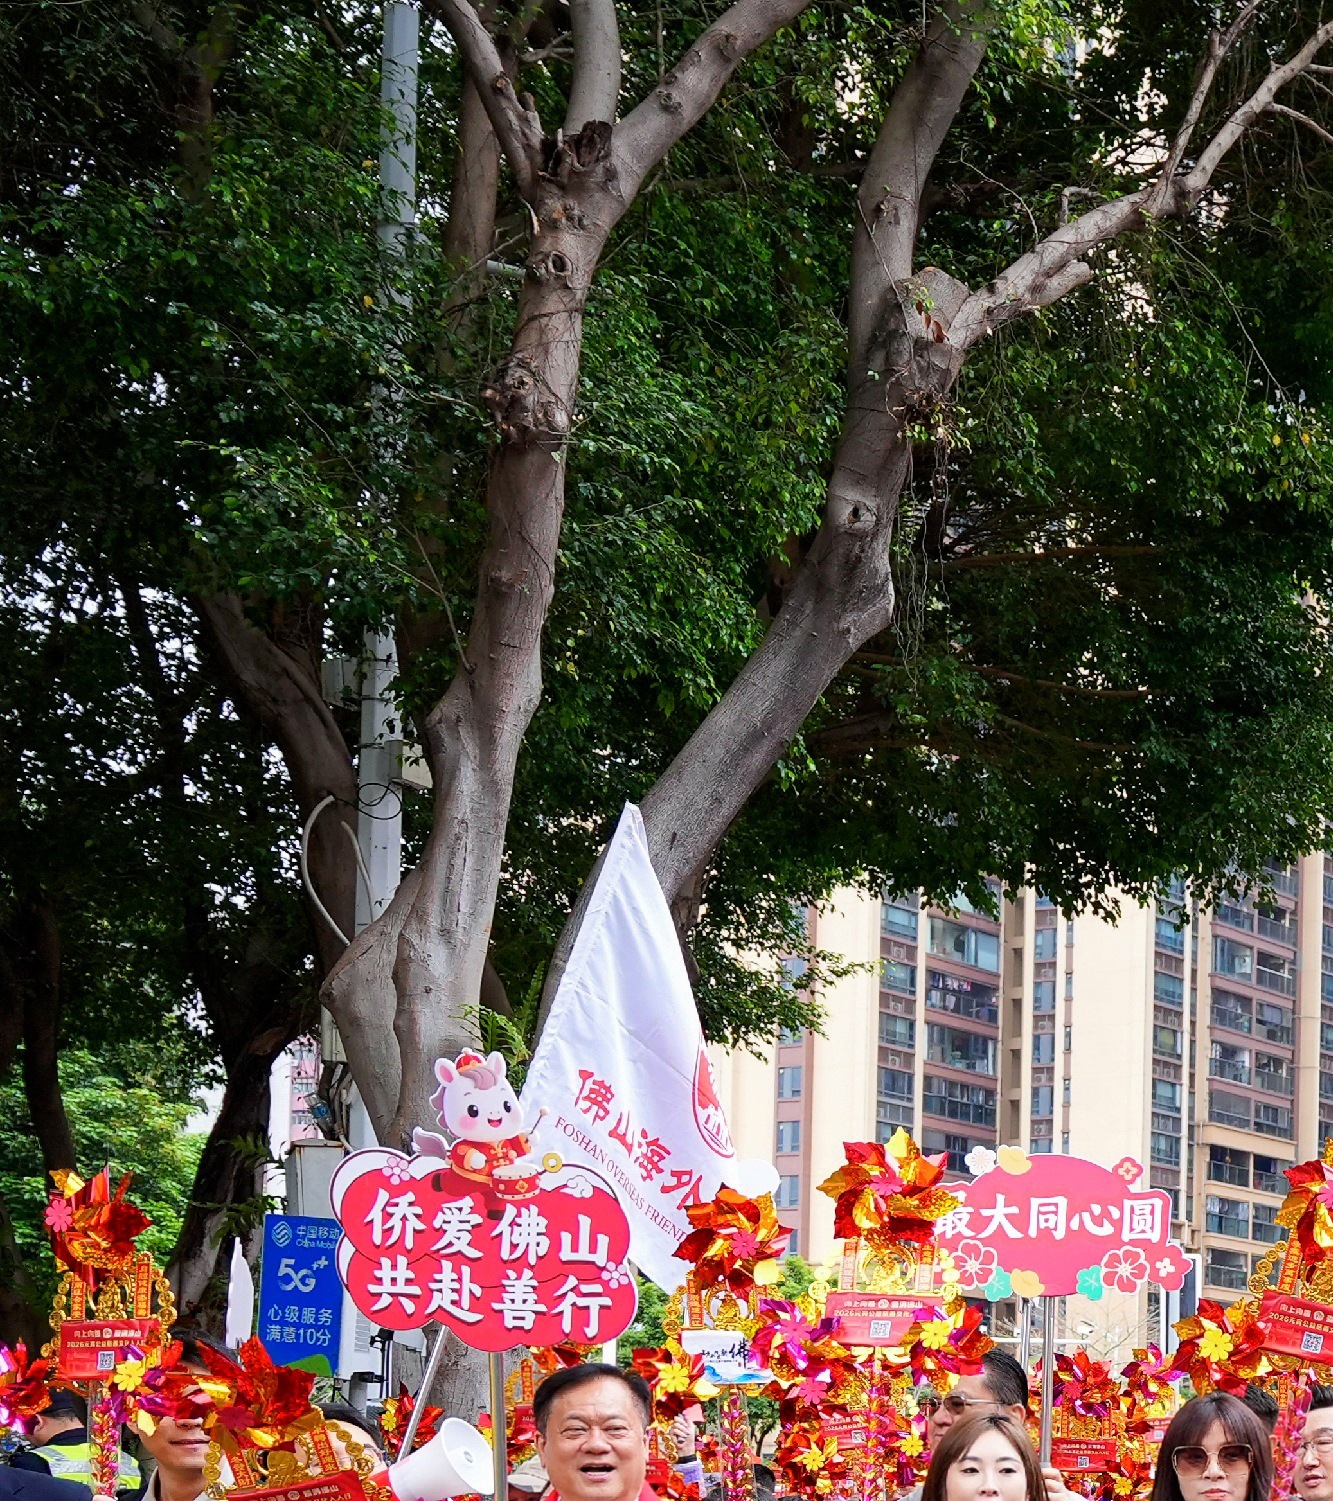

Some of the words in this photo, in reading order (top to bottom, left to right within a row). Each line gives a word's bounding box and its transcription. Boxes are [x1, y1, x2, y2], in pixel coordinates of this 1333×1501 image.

[555, 1116, 608, 1165] FOSHAN
[606, 1159, 645, 1210] OVERSEAS
[296, 1225, 340, 1239] 中国移动
[363, 1187, 611, 1268] 侨爱佛山
[267, 1303, 333, 1326] 心级服务
[366, 1254, 613, 1339] 共赴善行
[266, 1323, 332, 1347] 满意10分
